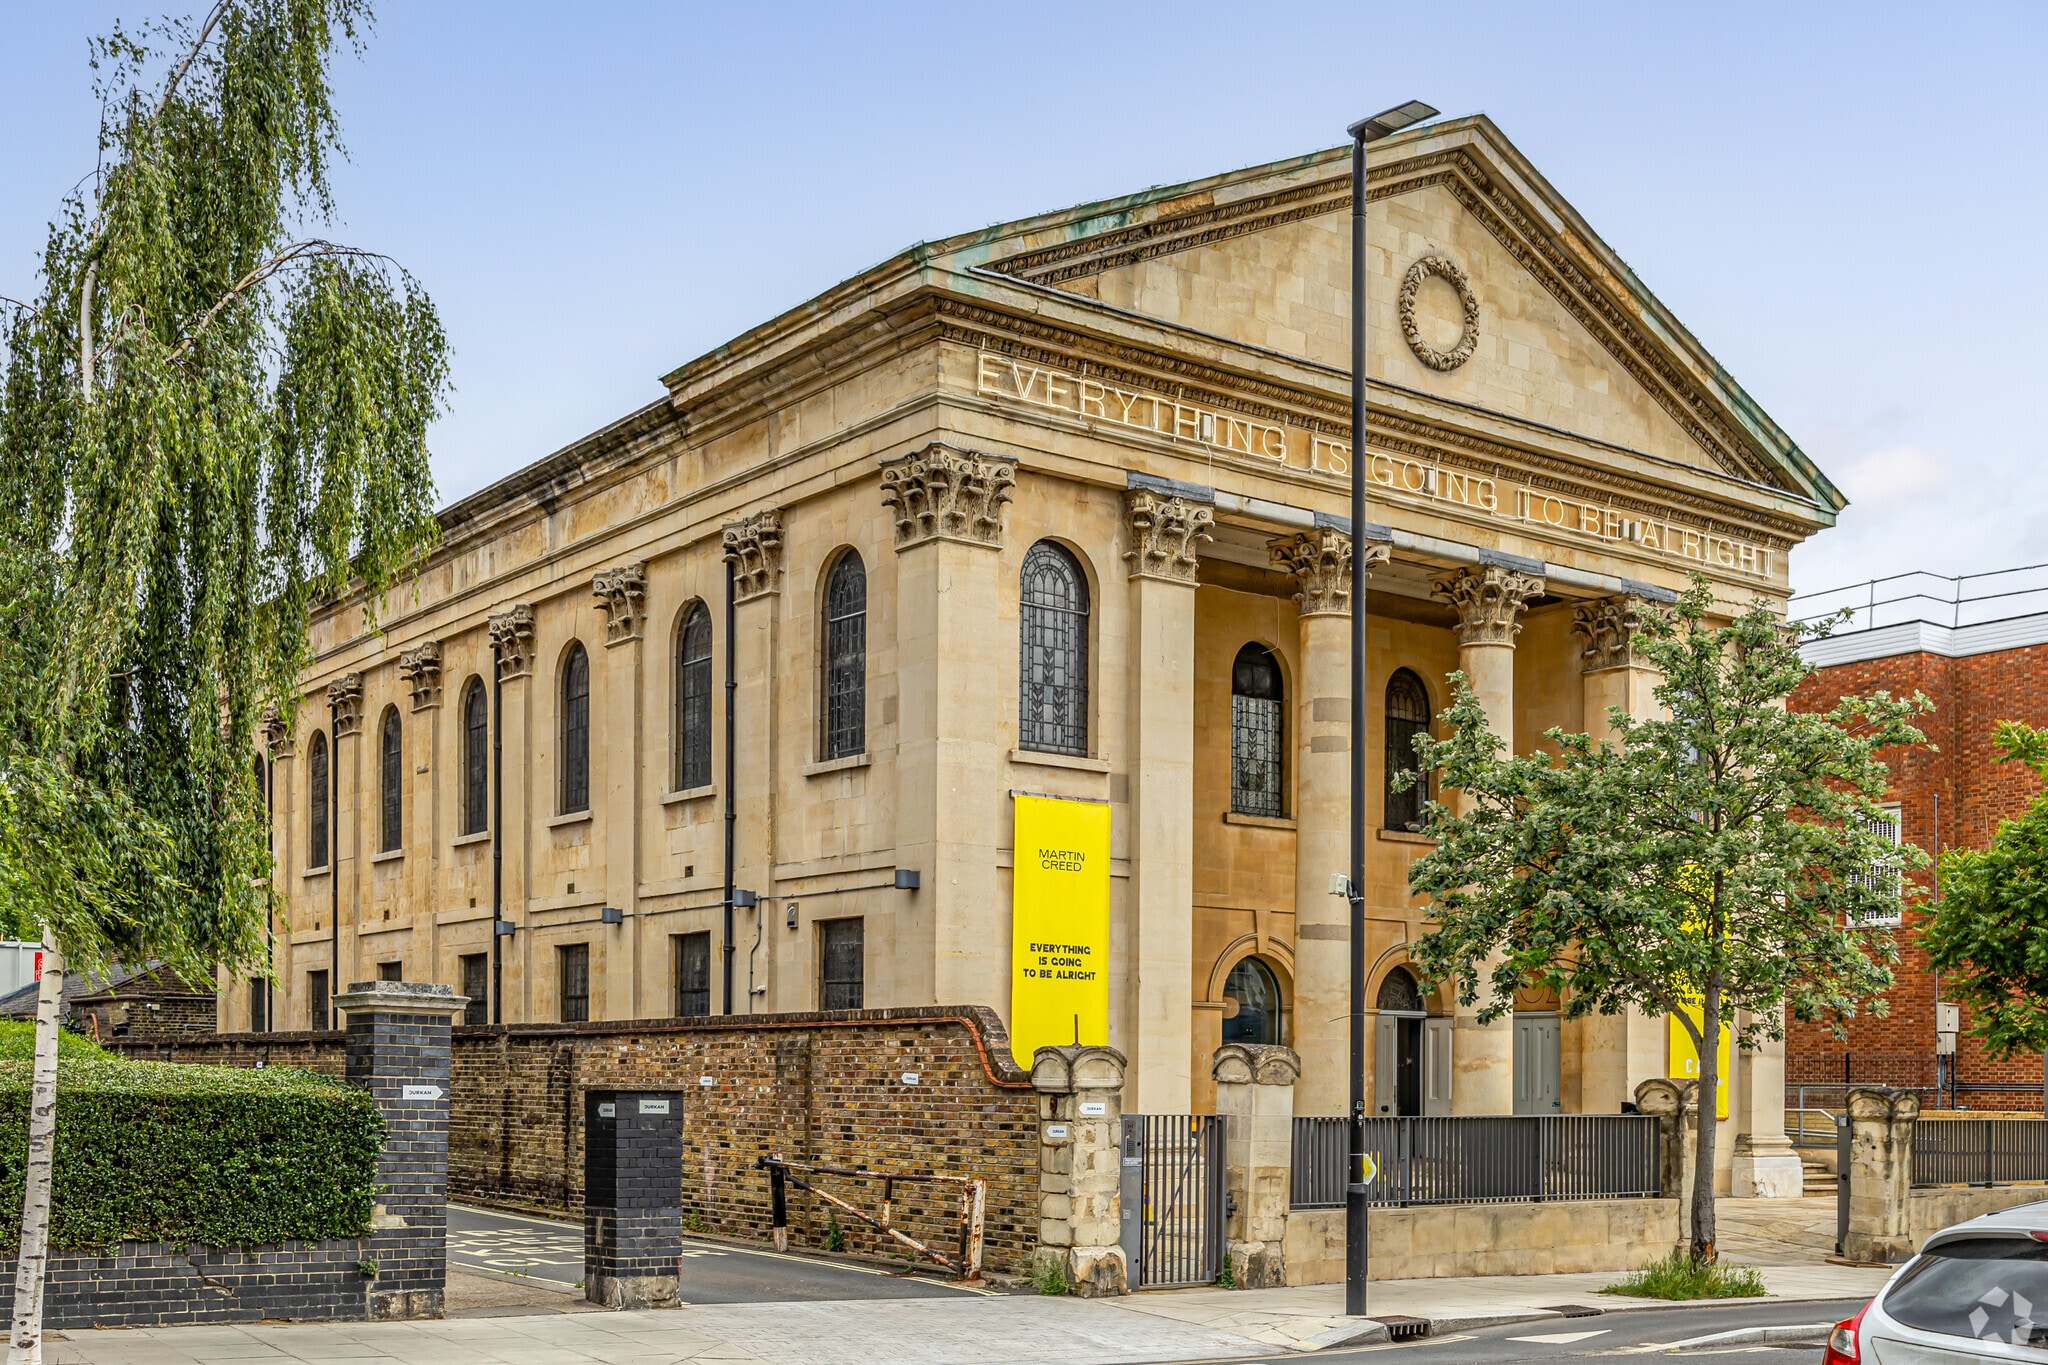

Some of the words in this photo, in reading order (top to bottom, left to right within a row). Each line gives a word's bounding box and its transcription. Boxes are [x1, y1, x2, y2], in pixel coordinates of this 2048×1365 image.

[979, 351, 1287, 462] EVERYTHING
[1312, 434, 1348, 475] IS
[1371, 453, 1498, 510] GOING
[1518, 488, 1564, 525] TO
[1582, 504, 1622, 540] BE
[1641, 518, 1775, 577] ALRIGHT
[1038, 849, 1085, 862] MARTIN
[1041, 860, 1082, 872] CREED
[1030, 943, 1091, 955] EVERYTHING
[1038, 957, 1047, 966] IS
[1051, 957, 1082, 967] GOING
[1023, 968, 1036, 978] TO
[1040, 969, 1052, 979] BE
[1056, 970, 1096, 981] ALRIGHT
